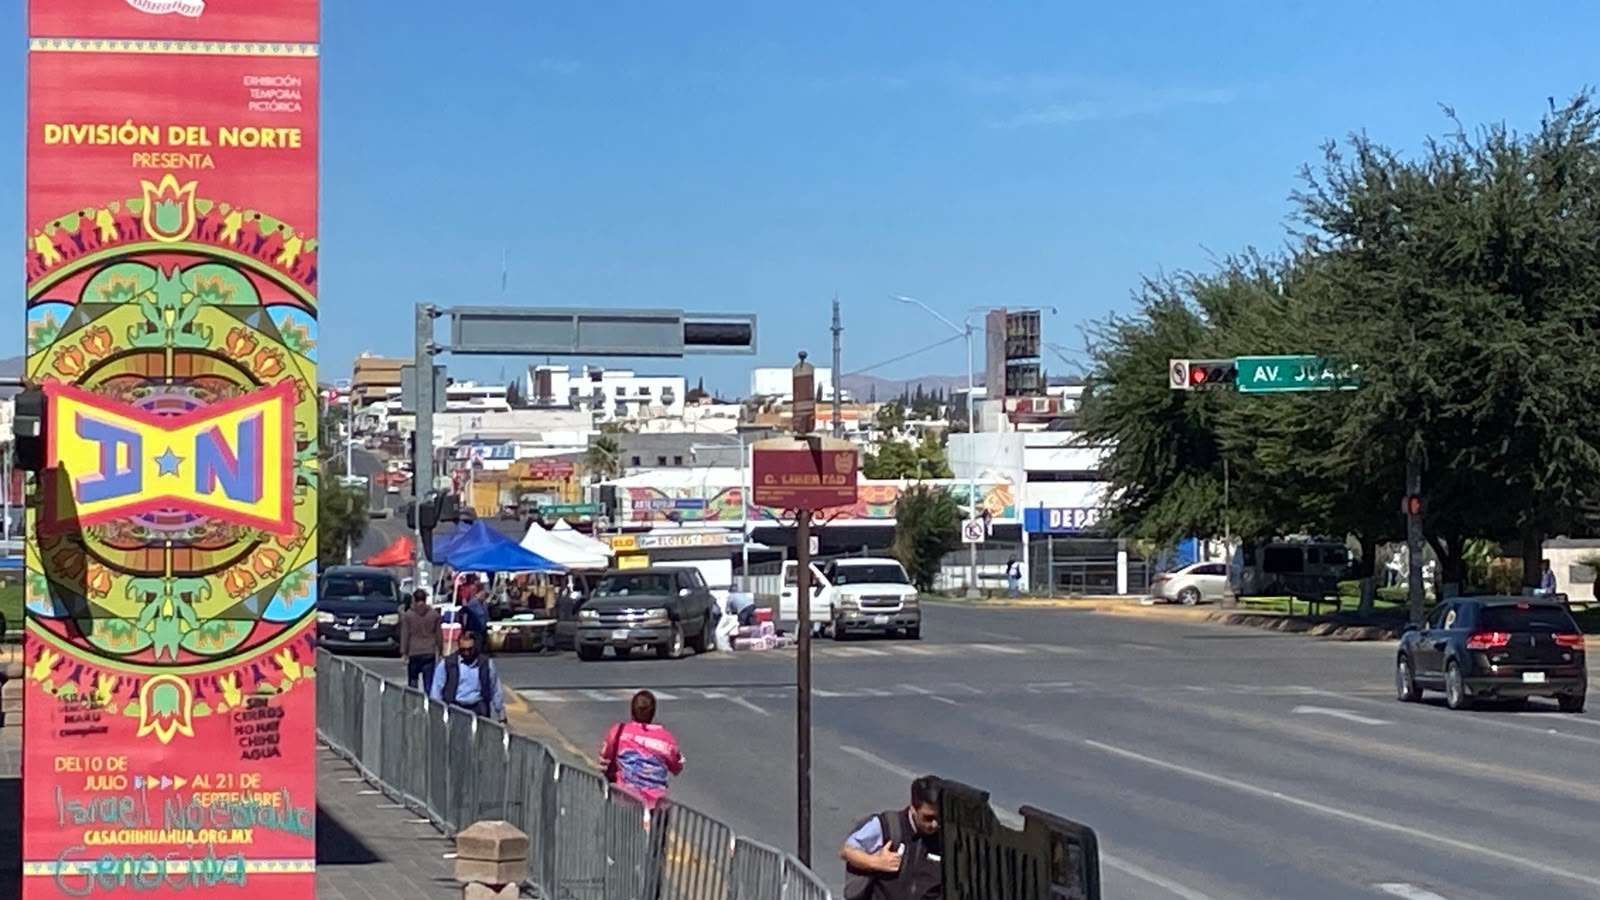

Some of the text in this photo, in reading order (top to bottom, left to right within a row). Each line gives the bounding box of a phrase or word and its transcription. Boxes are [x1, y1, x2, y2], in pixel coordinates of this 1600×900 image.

[249, 88, 302, 100] TEMPORAL
[248, 99, 302, 112] PICTÓRICA
[44, 119, 301, 148] DIVISIÓN DEL NORTE
[132, 152, 215, 169] PRESENTA
[1253, 365, 1282, 382] AV.
[764, 474, 847, 485] C. LIBERTAD
[54, 756, 83, 772] DEL
[106, 756, 127, 772] DE
[83, 775, 128, 791] JULIO
[191, 773, 262, 789] AL 21 DE
[83, 829, 253, 845] CASACHIHUAHUA.ORG.MX
